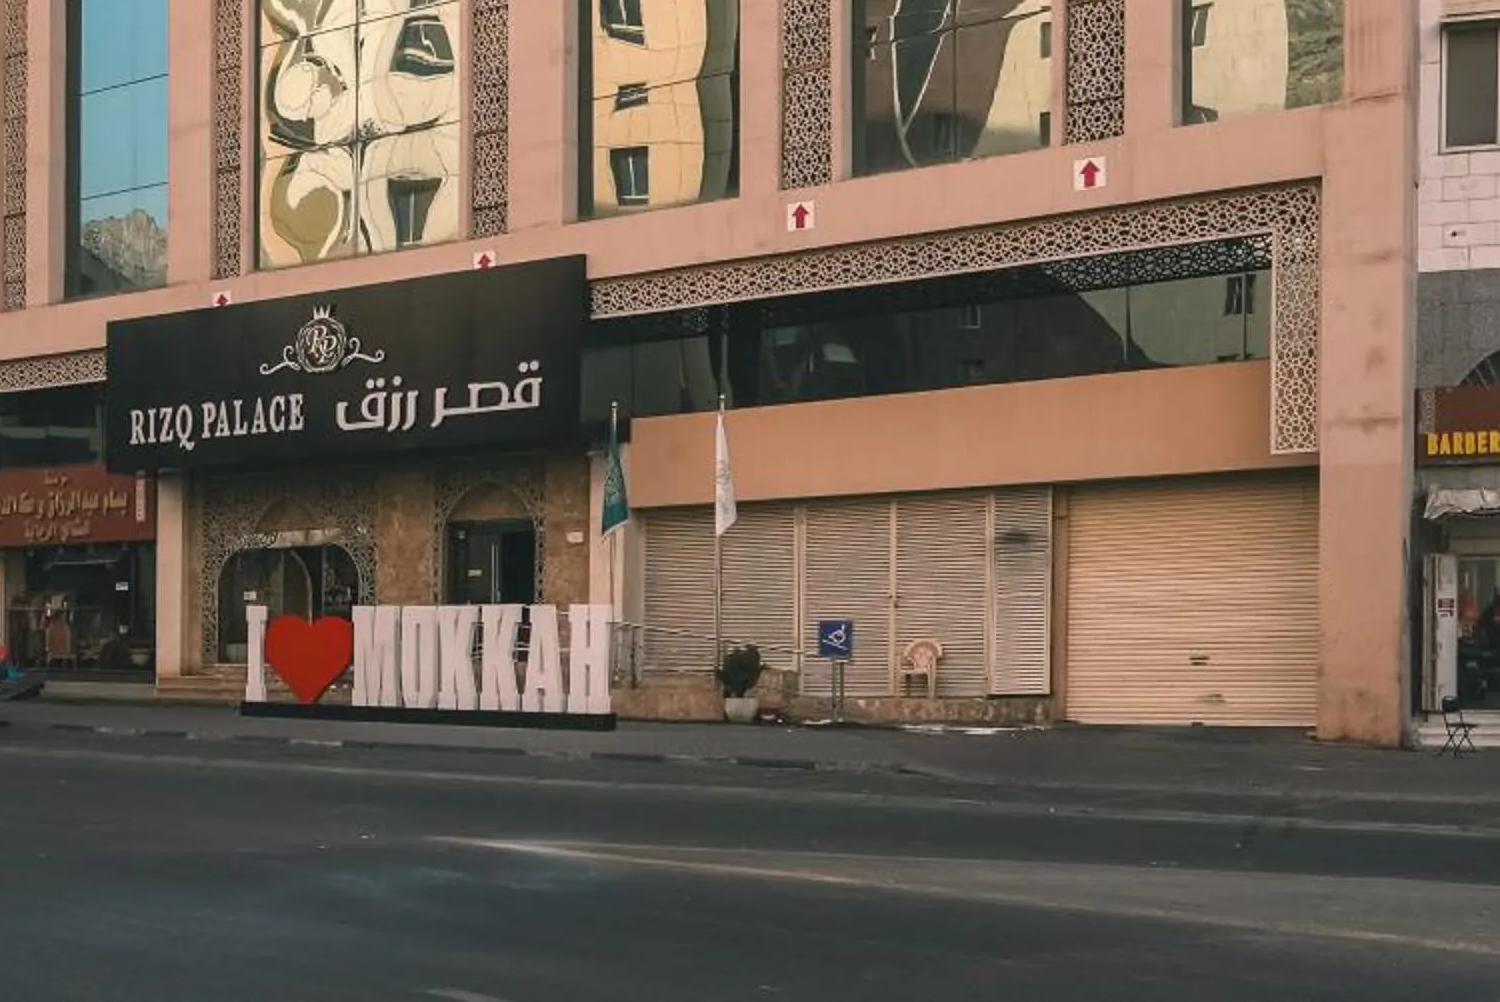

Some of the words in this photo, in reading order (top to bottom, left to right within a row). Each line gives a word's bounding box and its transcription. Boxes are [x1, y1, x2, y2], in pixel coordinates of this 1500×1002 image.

[129, 405, 195, 451] RIZQ
[201, 392, 305, 441] PALACE
[336, 376, 417, 432] رزق
[430, 359, 543, 430] قصر
[1427, 430, 1500, 456] BARBER
[246, 605, 268, 701] I
[352, 604, 611, 714] MOKKAH
